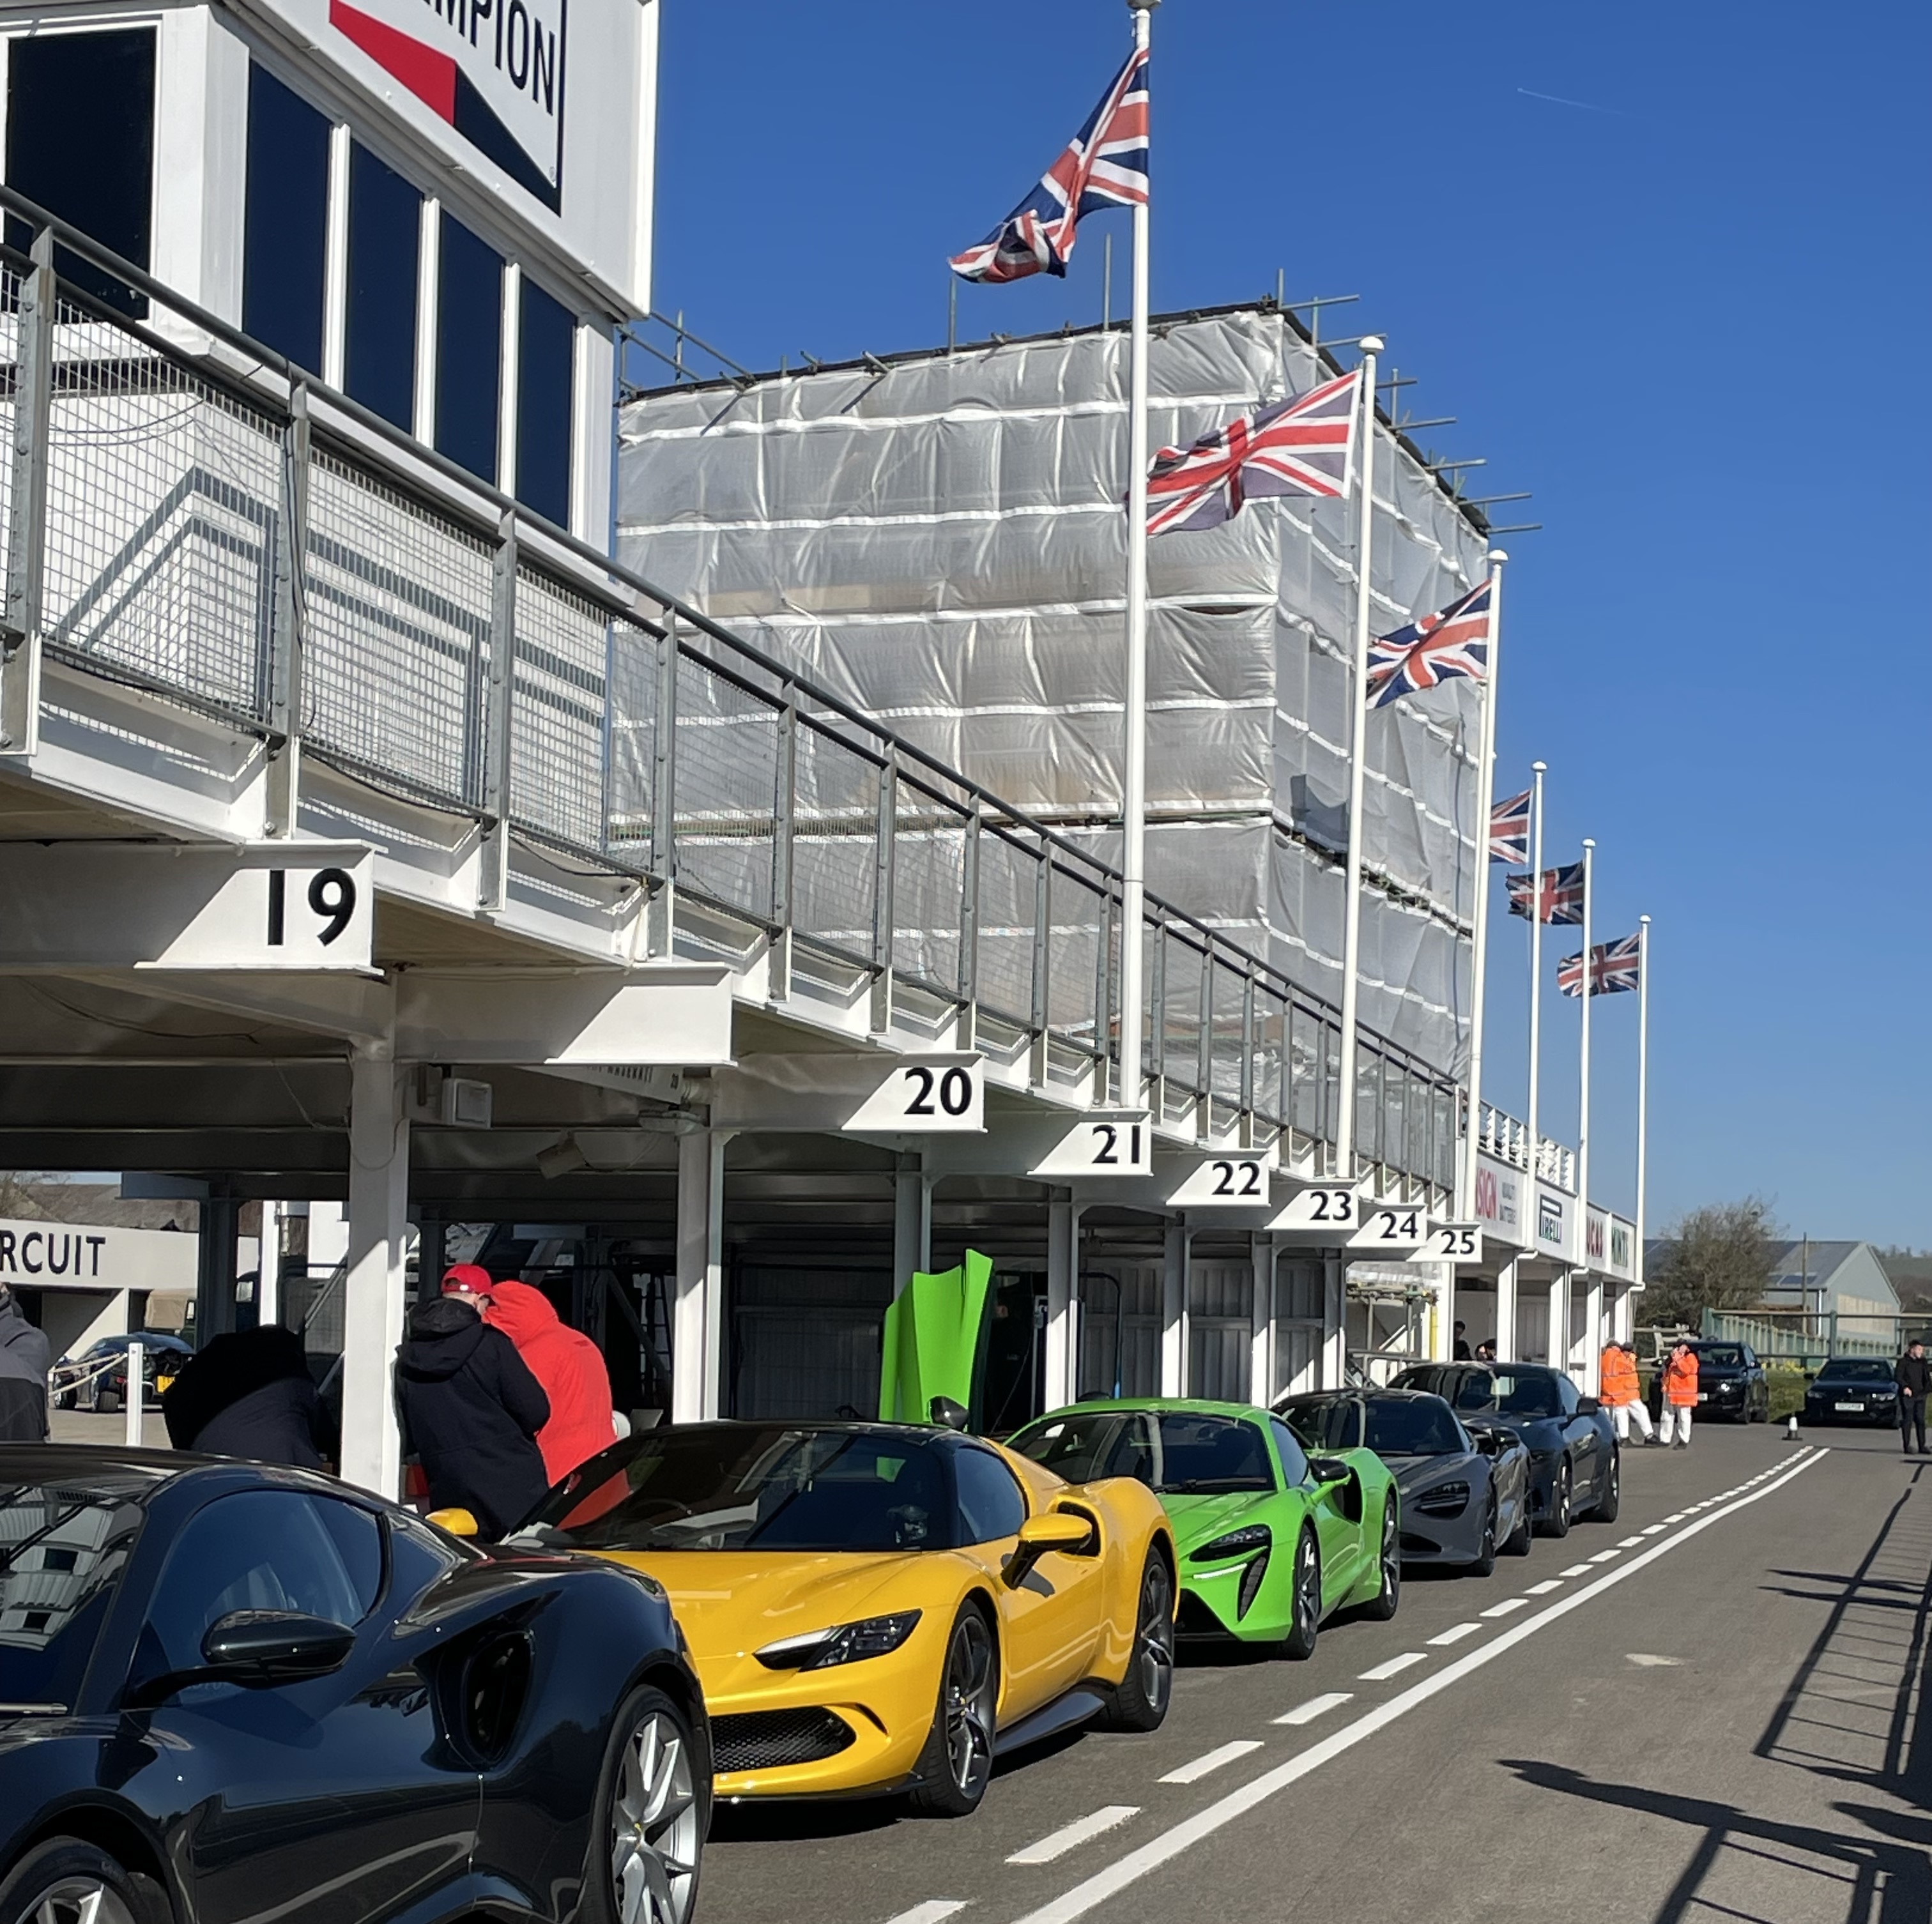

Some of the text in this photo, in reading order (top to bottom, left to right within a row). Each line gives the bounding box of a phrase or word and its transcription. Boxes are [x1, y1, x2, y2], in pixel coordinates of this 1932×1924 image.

[268, 867, 356, 947] 19
[904, 1067, 972, 1115] 20
[1092, 1125, 1140, 1164] 21
[1211, 1161, 1261, 1195] 22
[1309, 1191, 1352, 1221] 23
[1379, 1212, 1418, 1239] 24
[1440, 1230, 1475, 1255] 25
